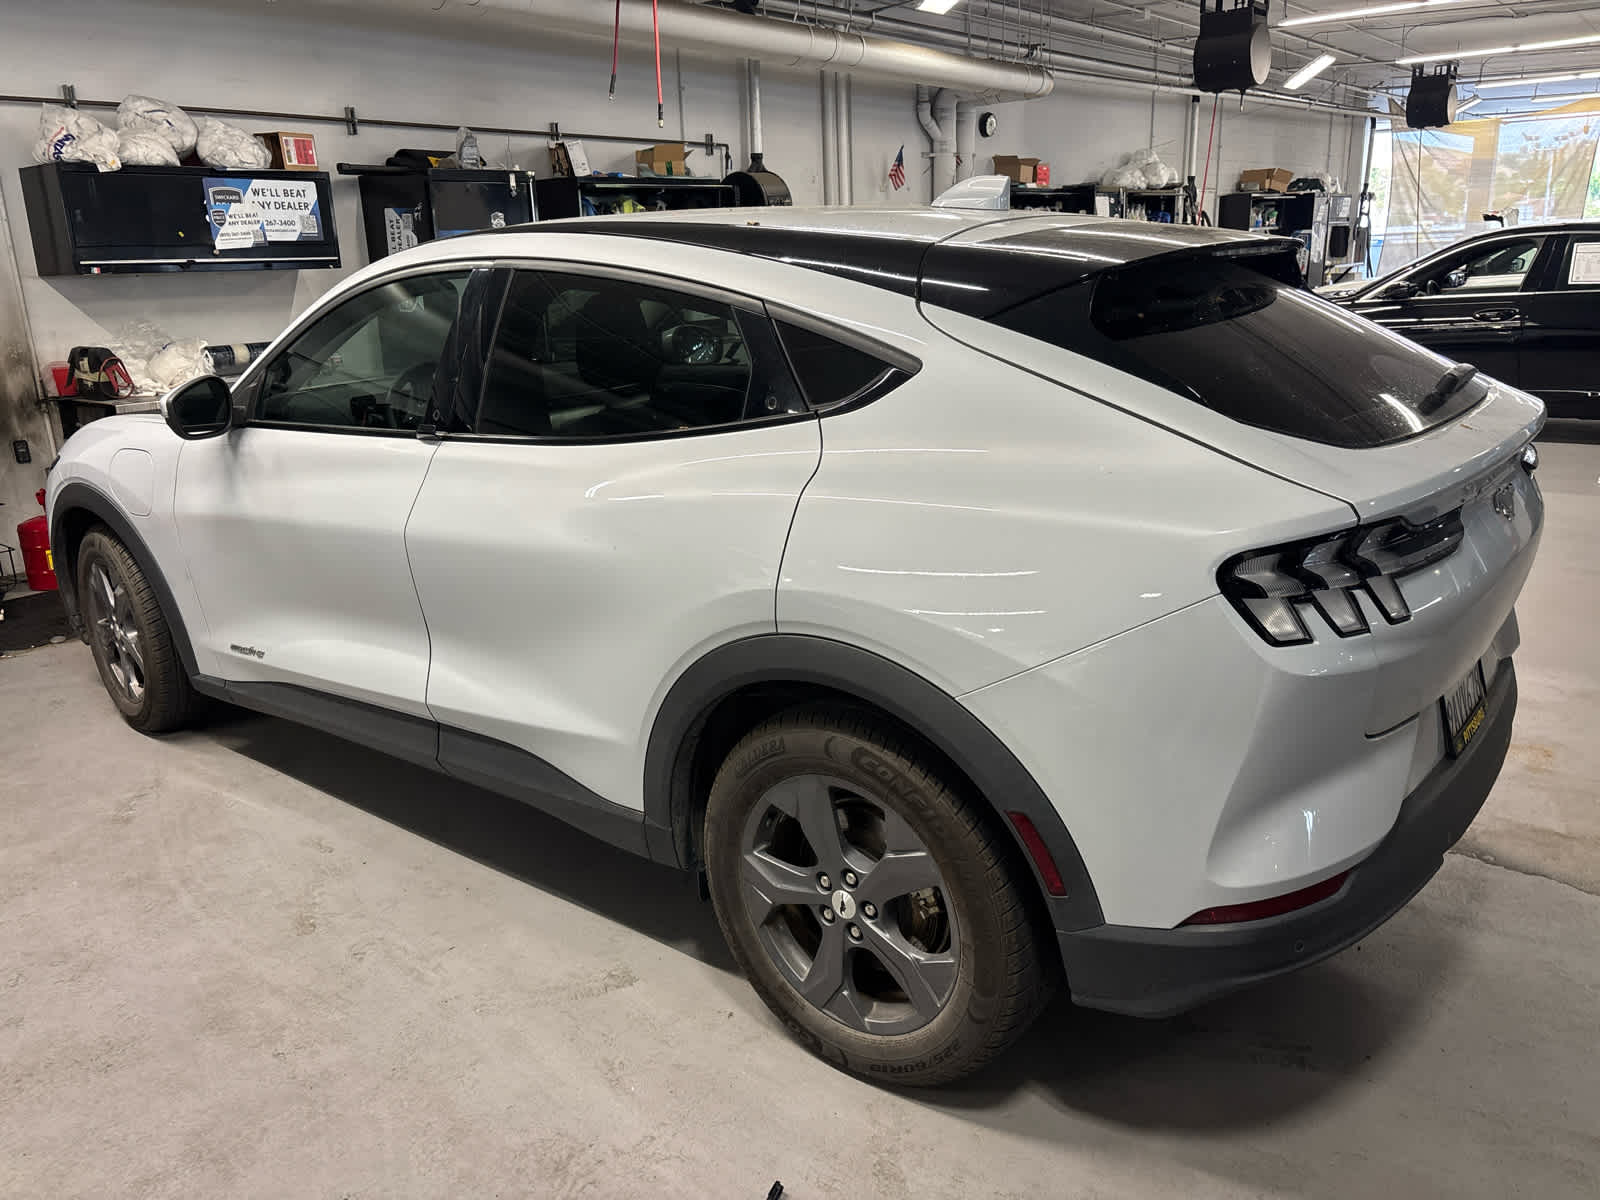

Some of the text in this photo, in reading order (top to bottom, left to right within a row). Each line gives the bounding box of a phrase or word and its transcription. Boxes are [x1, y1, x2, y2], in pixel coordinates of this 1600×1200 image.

[250, 187, 306, 198] WE'LL BEAT
[273, 201, 310, 211] DEALER
